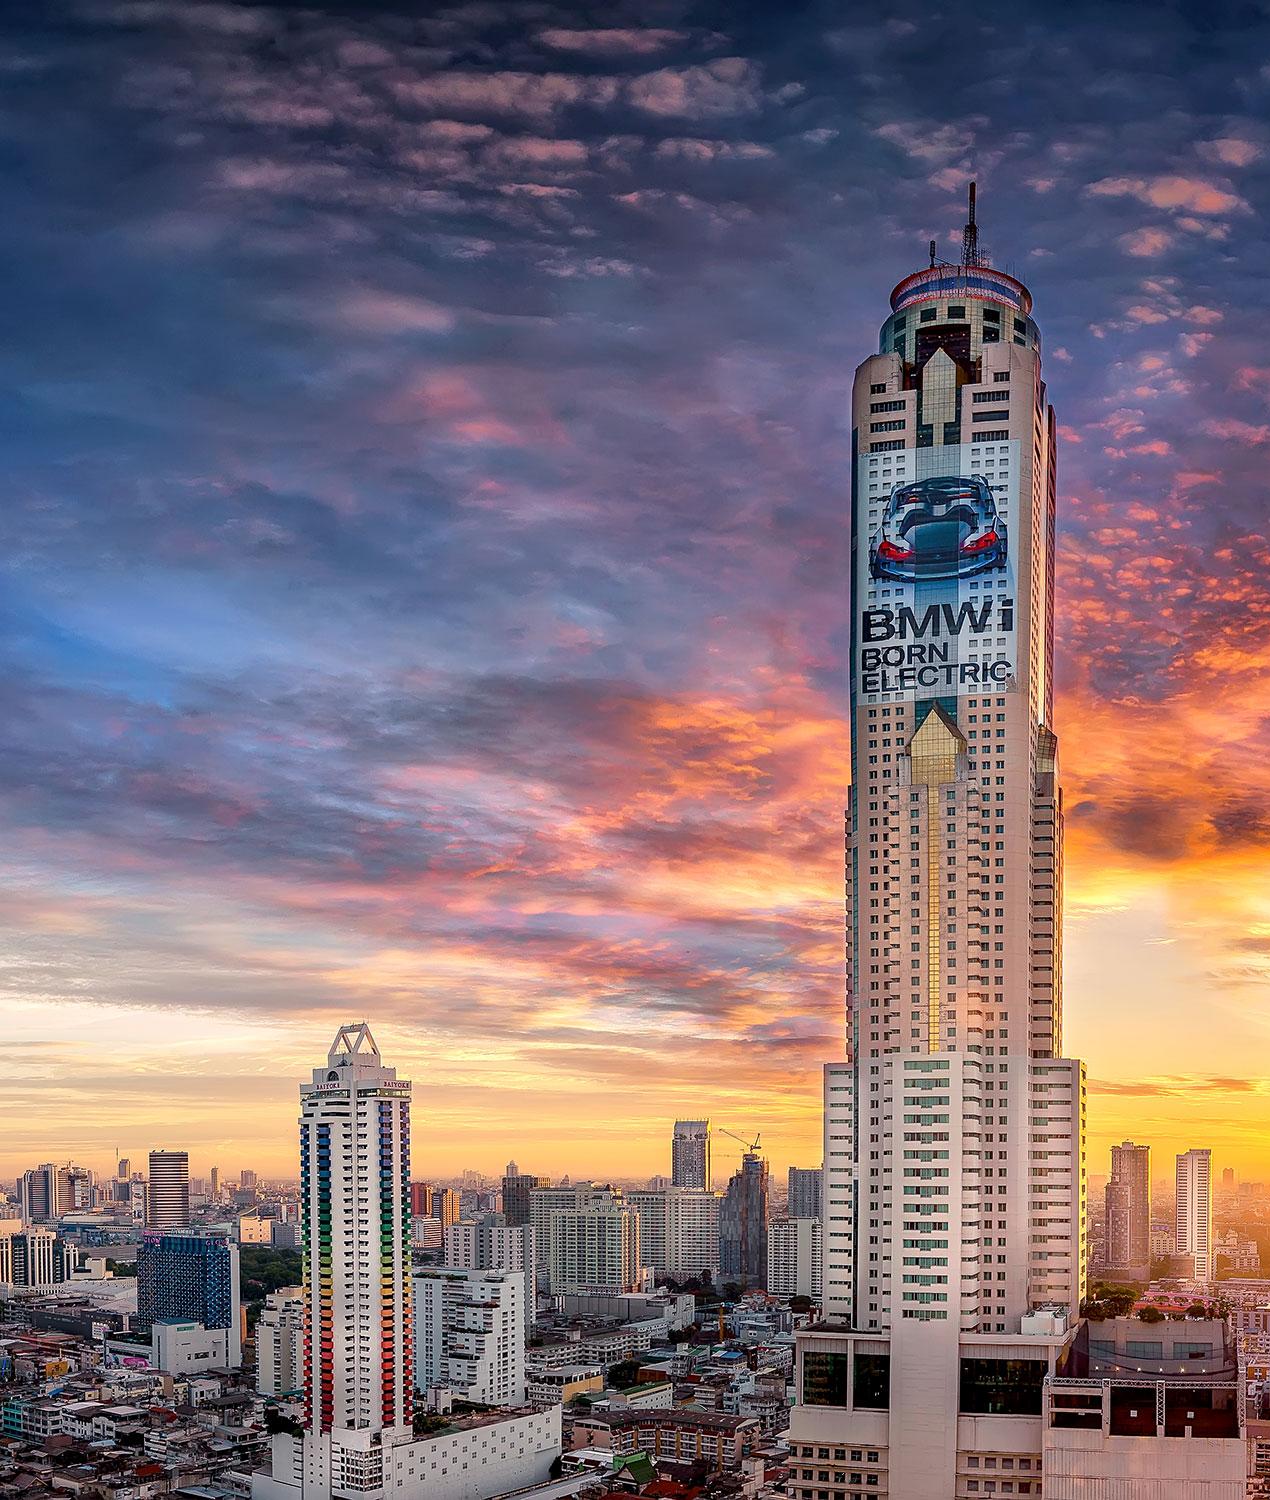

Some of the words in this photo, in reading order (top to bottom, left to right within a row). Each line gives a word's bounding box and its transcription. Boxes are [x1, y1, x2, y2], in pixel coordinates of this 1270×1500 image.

[861, 599, 993, 643] BMW
[1001, 598, 1014, 632] i
[861, 641, 949, 672] BORN
[861, 660, 1013, 694] ELECTRIC
[383, 1081, 410, 1089] BAIYOKE
